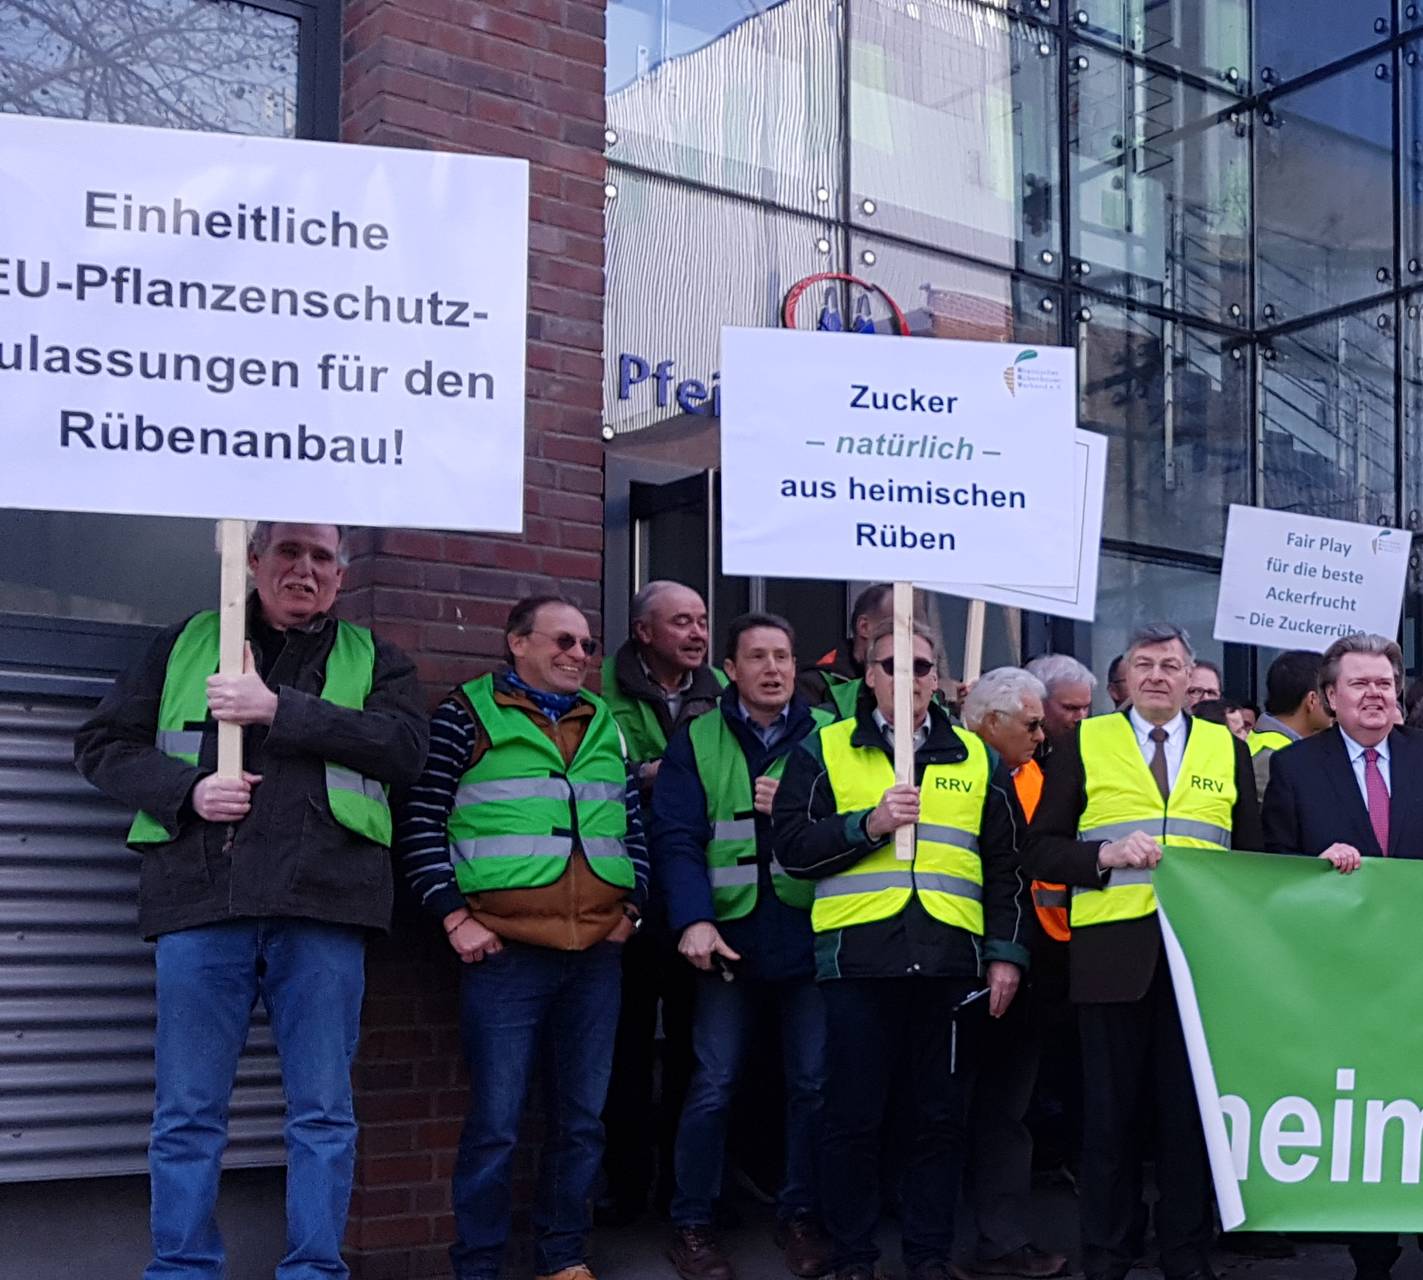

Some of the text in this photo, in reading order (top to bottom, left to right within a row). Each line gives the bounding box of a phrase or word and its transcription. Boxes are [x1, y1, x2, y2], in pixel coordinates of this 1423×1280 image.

[84, 190, 390, 250] Einheitliche
[318, 354, 389, 393] für
[404, 360, 495, 400] den
[849, 385, 958, 414] Zucker
[59, 409, 404, 465] Rübenanbau!
[836, 432, 975, 461] natürlich
[780, 477, 1026, 509] aus heimischen
[856, 522, 956, 551] Rüben
[1286, 532, 1352, 558] Fair Play
[1266, 557, 1364, 584] für die beste
[1266, 586, 1357, 612] Ackerfrucht
[1250, 612, 1275, 628] Die
[935, 776, 973, 793] RRV
[1190, 775, 1224, 793] RRV
